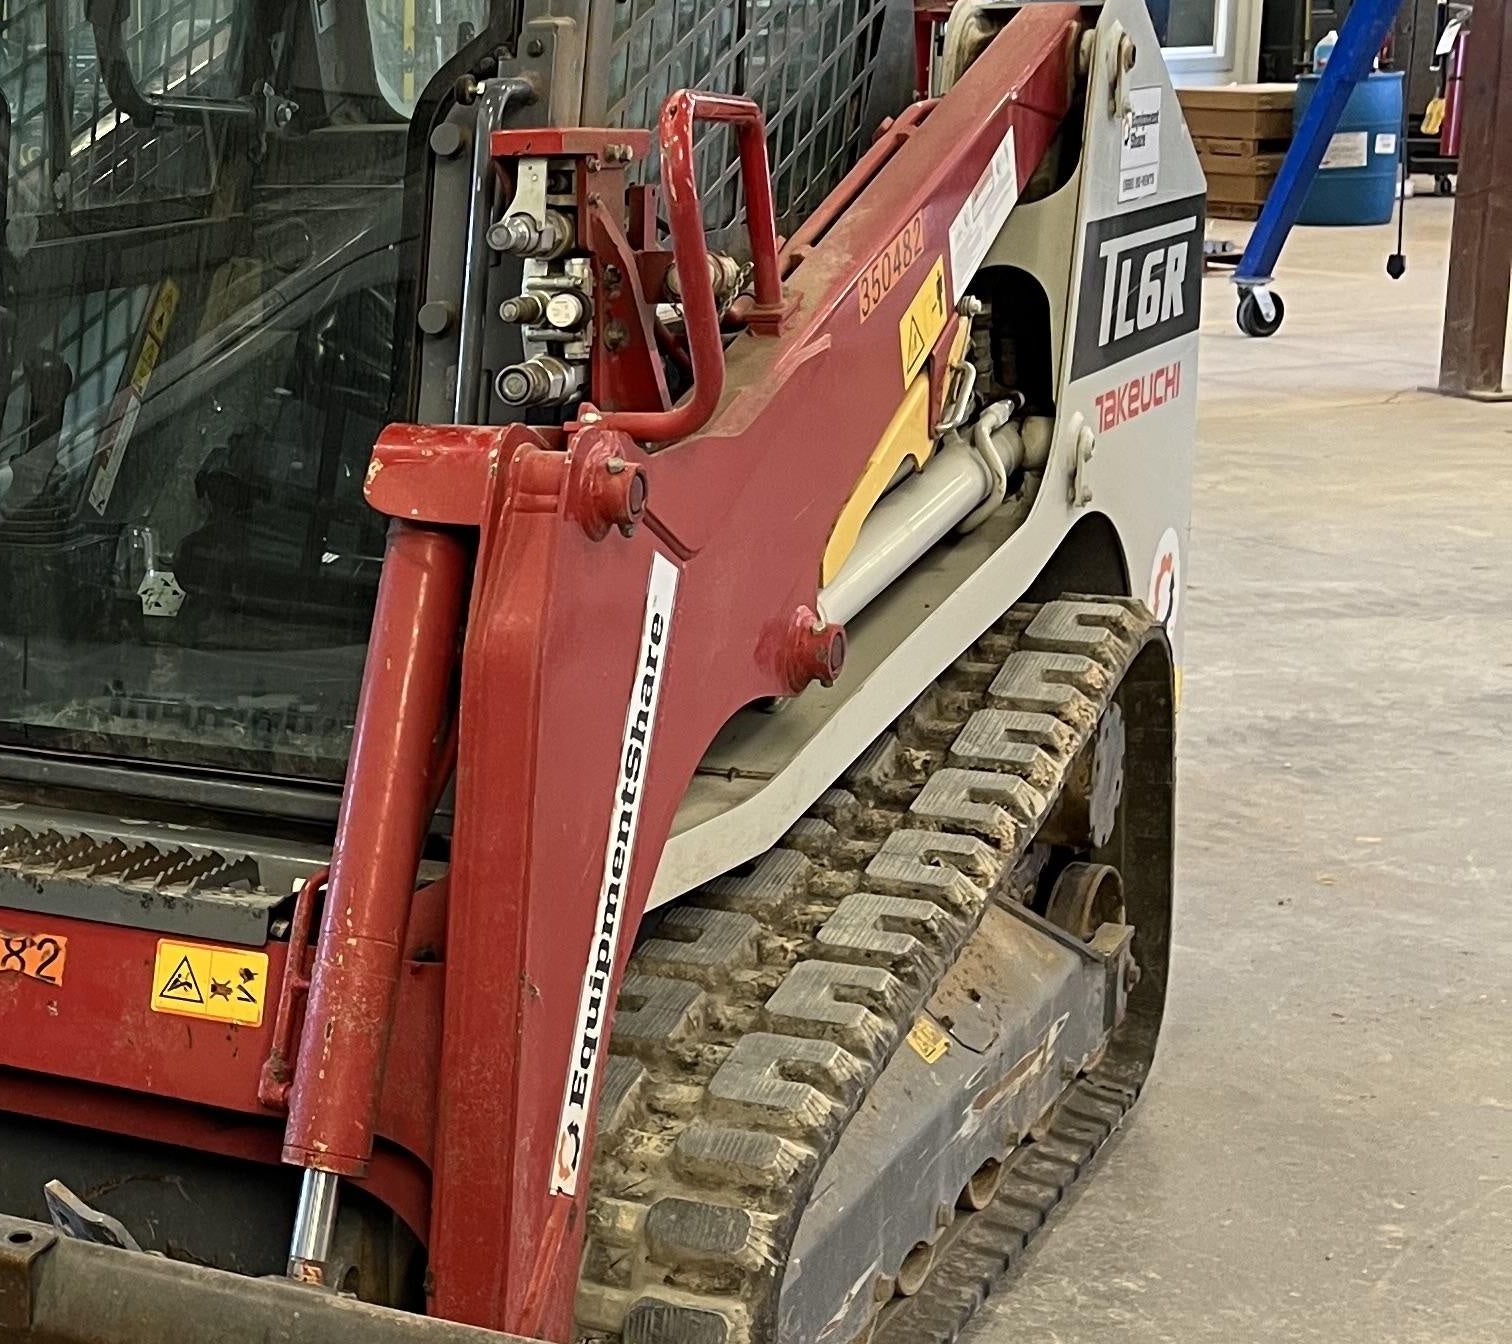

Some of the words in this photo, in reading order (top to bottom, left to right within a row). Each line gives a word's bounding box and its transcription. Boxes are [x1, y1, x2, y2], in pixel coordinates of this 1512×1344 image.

[860, 216, 923, 317] 350482
[1098, 215, 1197, 347] TL6R
[568, 612, 665, 1108] EquipmentShare
